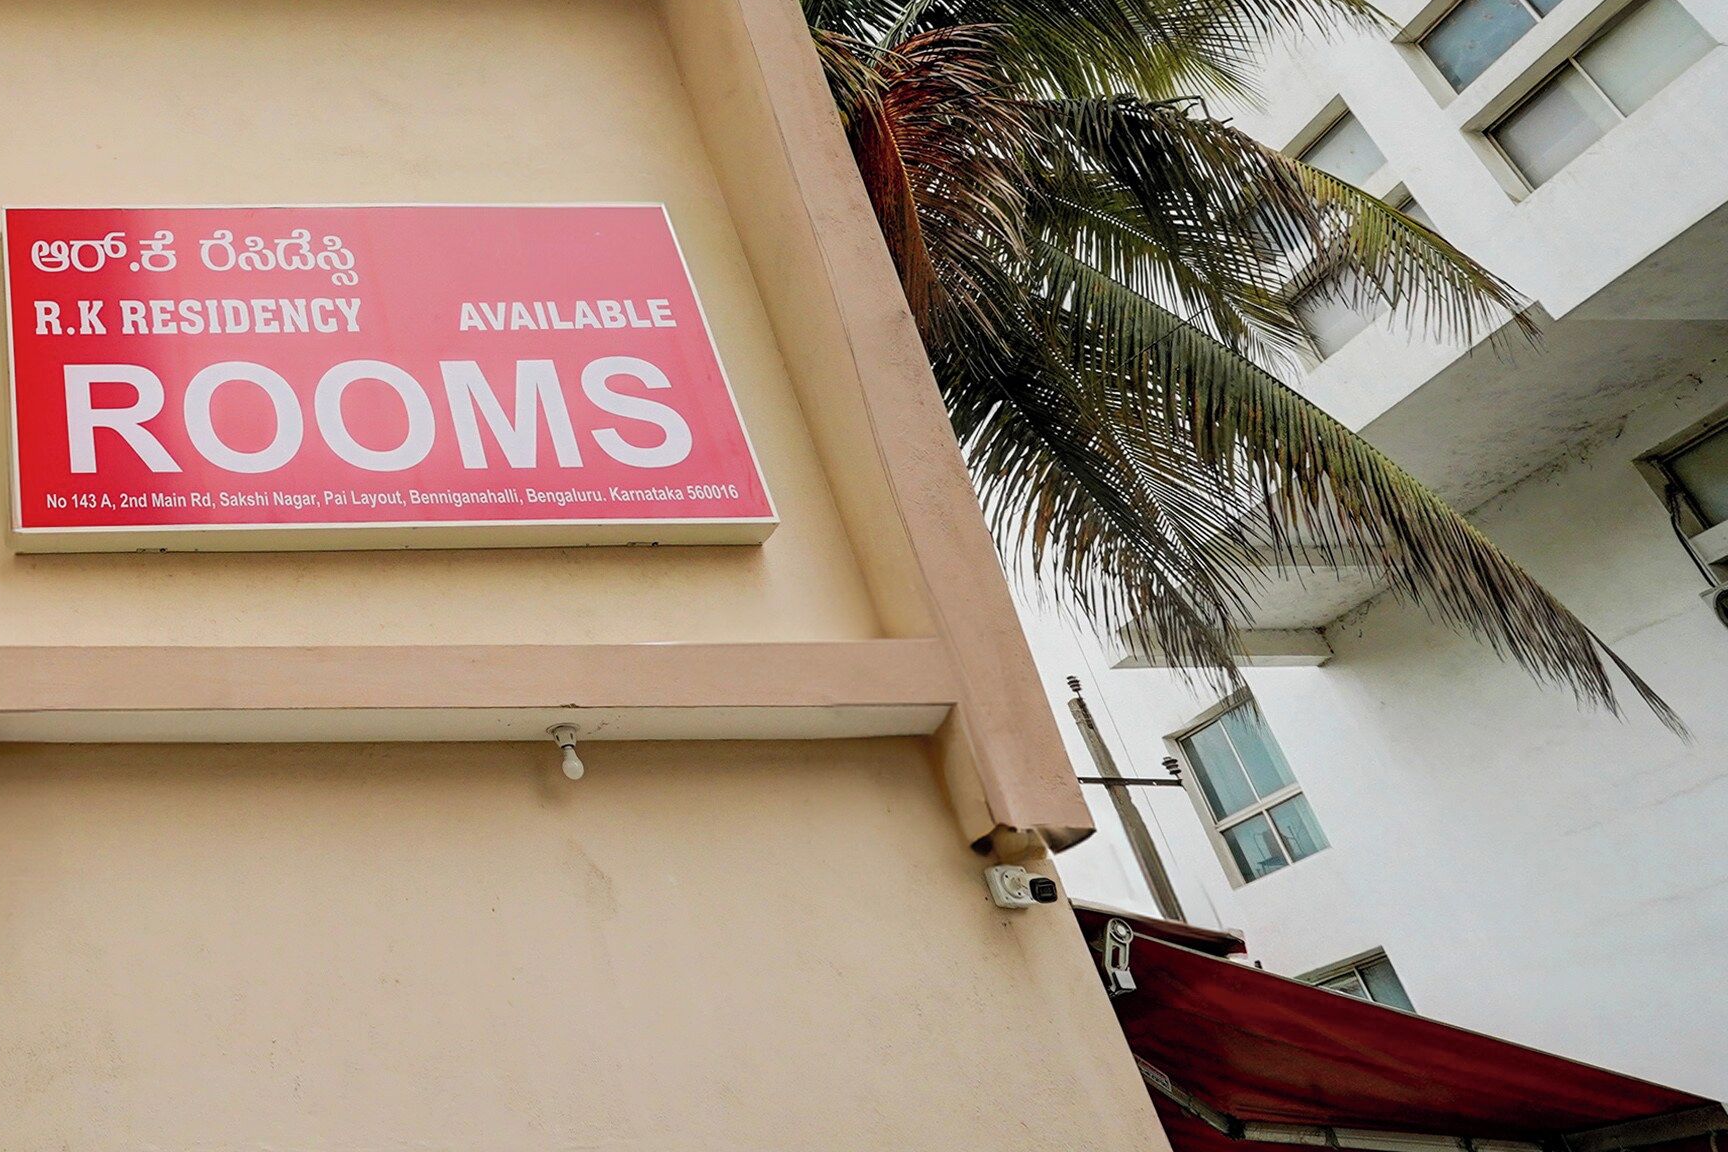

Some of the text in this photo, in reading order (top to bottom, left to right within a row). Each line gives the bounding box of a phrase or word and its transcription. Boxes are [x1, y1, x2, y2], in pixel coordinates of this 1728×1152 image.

[30, 230, 177, 273] ಆರ್.ಕೆ
[34, 298, 361, 335] R.K RESIDENCY
[459, 298, 677, 332] AVAILABLE
[62, 355, 693, 475] ROOMS
[46, 484, 740, 510] No 143 A, 2nd Main Rd, Sakshi Nagar, Pai Layout, Benniganahalli, Bengaluru. Karnataka 560016
